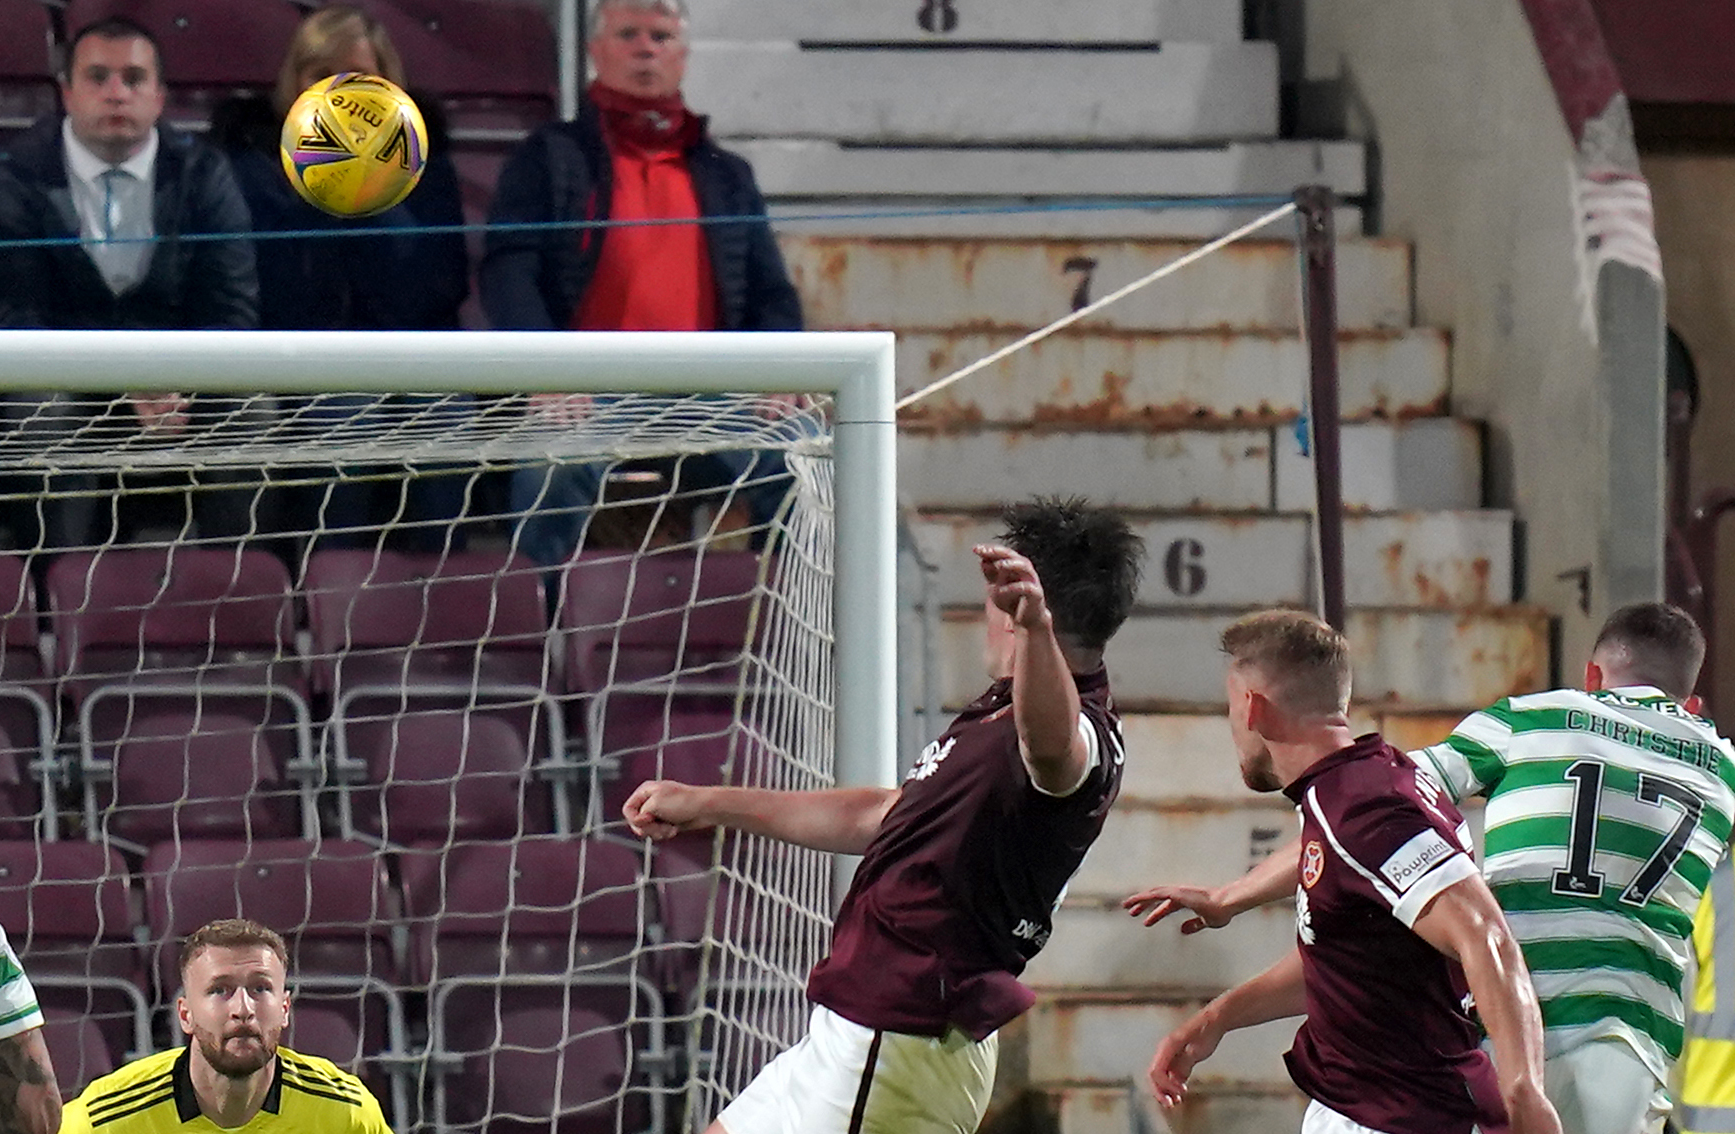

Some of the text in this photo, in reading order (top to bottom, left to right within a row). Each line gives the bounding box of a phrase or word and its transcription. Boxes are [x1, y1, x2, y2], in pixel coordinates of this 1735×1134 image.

[332, 95, 383, 128] mitre
[1062, 257, 1098, 311] 7
[1164, 538, 1208, 597] 6
[1568, 709, 1723, 776] CHRISTIE
[1552, 759, 1705, 908] 17
[1393, 840, 1448, 884] pawprint
